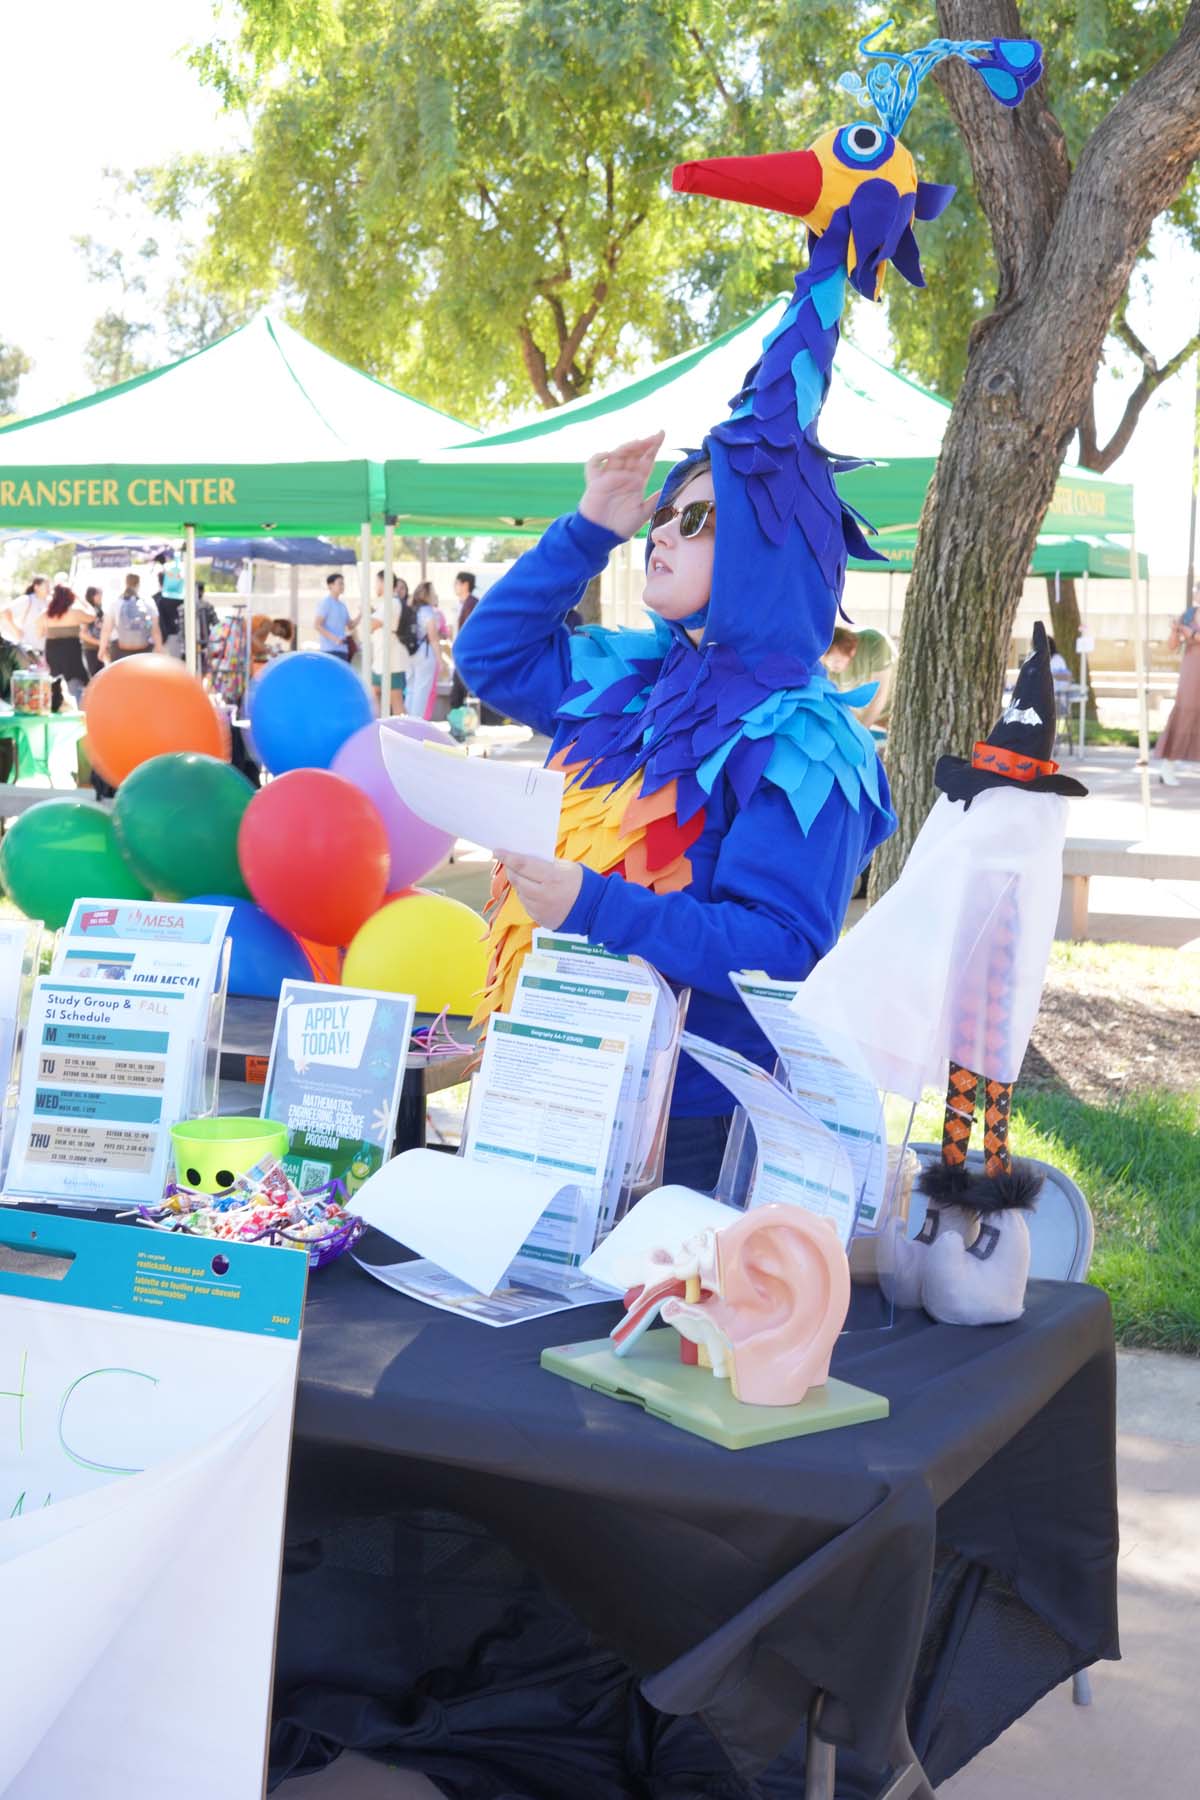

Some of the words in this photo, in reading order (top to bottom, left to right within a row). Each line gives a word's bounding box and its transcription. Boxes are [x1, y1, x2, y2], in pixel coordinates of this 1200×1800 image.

[127, 478, 237, 506] CENTER
[143, 914, 185, 929] MESA
[47, 994, 80, 1009] Study
[84, 996, 120, 1011] Group
[123, 999, 132, 1009] &
[45, 1009, 56, 1019] SI
[59, 1010, 112, 1023] Schedule
[305, 1006, 350, 1031] APPLY
[46, 1027, 57, 1042] M
[301, 1031, 351, 1057] TODAY!
[42, 1059, 56, 1074] TU
[35, 1093, 59, 1110] WED
[288, 1118, 335, 1136] ACHIEVEMENT
[335, 1110, 365, 1128] SCIENCE
[30, 1134, 51, 1149] THU
[304, 1133, 340, 1150] PROGRAM
[191, 1268, 206, 1278] pad
